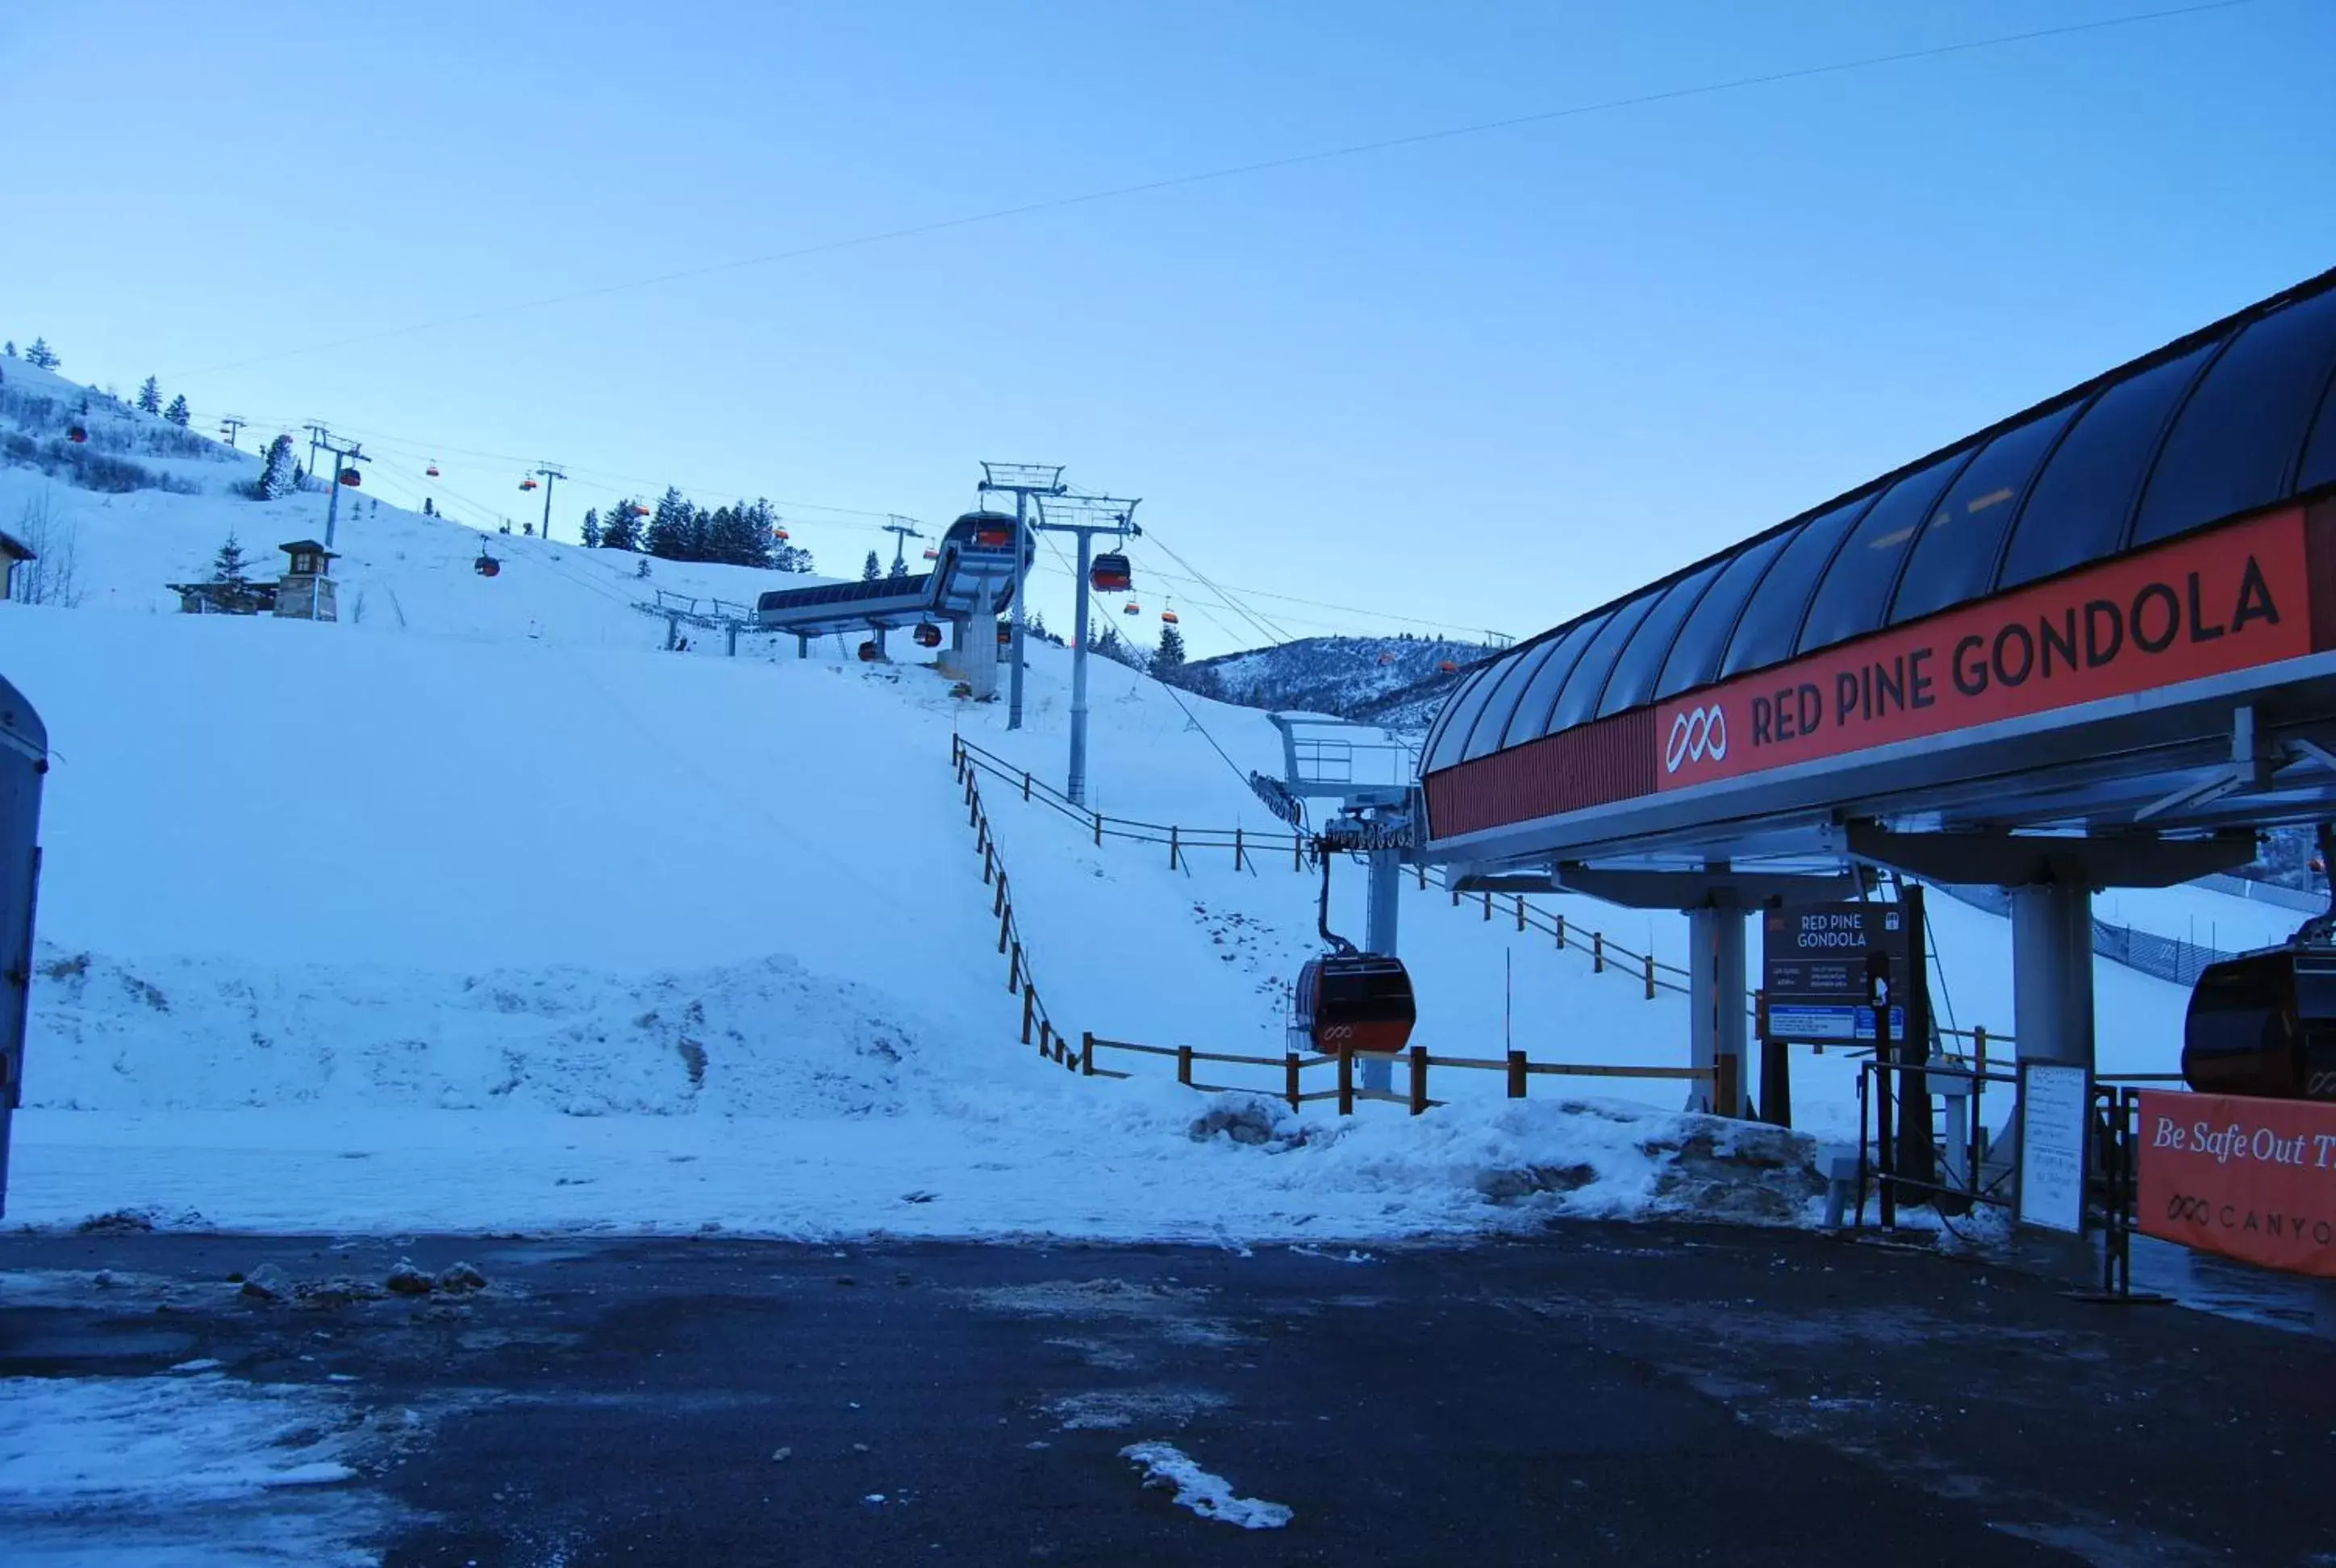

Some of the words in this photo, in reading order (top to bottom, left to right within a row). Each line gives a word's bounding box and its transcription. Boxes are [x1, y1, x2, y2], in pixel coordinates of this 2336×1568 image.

[1752, 683, 1821, 747] RED
[1836, 648, 1935, 726] PINE
[1951, 555, 2280, 696] GONDOLA
[1797, 932, 1867, 948] GONDOLA
[1801, 915, 1828, 930] RED
[1831, 914, 1863, 929] PINE
[2153, 1117, 2185, 1149] Be
[2190, 1122, 2248, 1163] Safe
[2252, 1128, 2305, 1164] Out
[2313, 1134, 2336, 1169] T
[2220, 1205, 2331, 1245] CANYO
